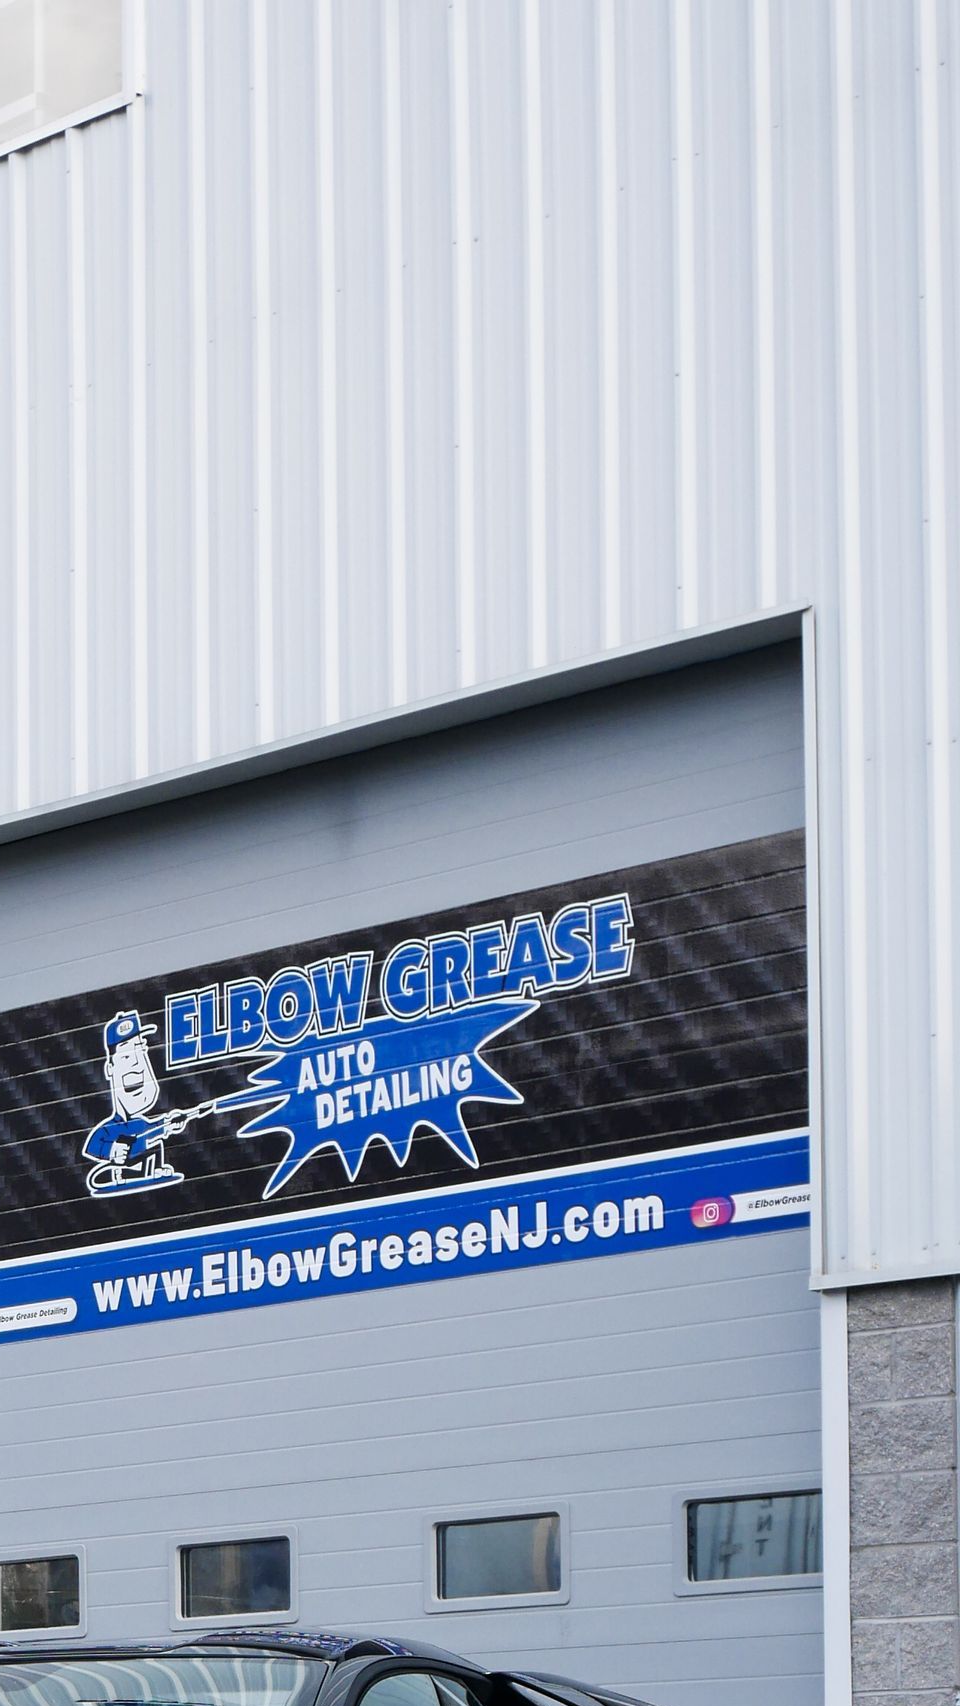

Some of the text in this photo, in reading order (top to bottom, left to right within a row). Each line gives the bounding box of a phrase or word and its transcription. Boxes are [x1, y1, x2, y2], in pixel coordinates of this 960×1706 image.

[167, 893, 634, 1068] ELBOW GREASE
[296, 1040, 376, 1094] AUTO
[315, 1054, 473, 1130] DETAILING
[93, 1194, 665, 1314] www.ElbowGreaseNJ.com
[16, 1312, 38, 1321] Grease
[39, 1307, 68, 1317] Detailing
